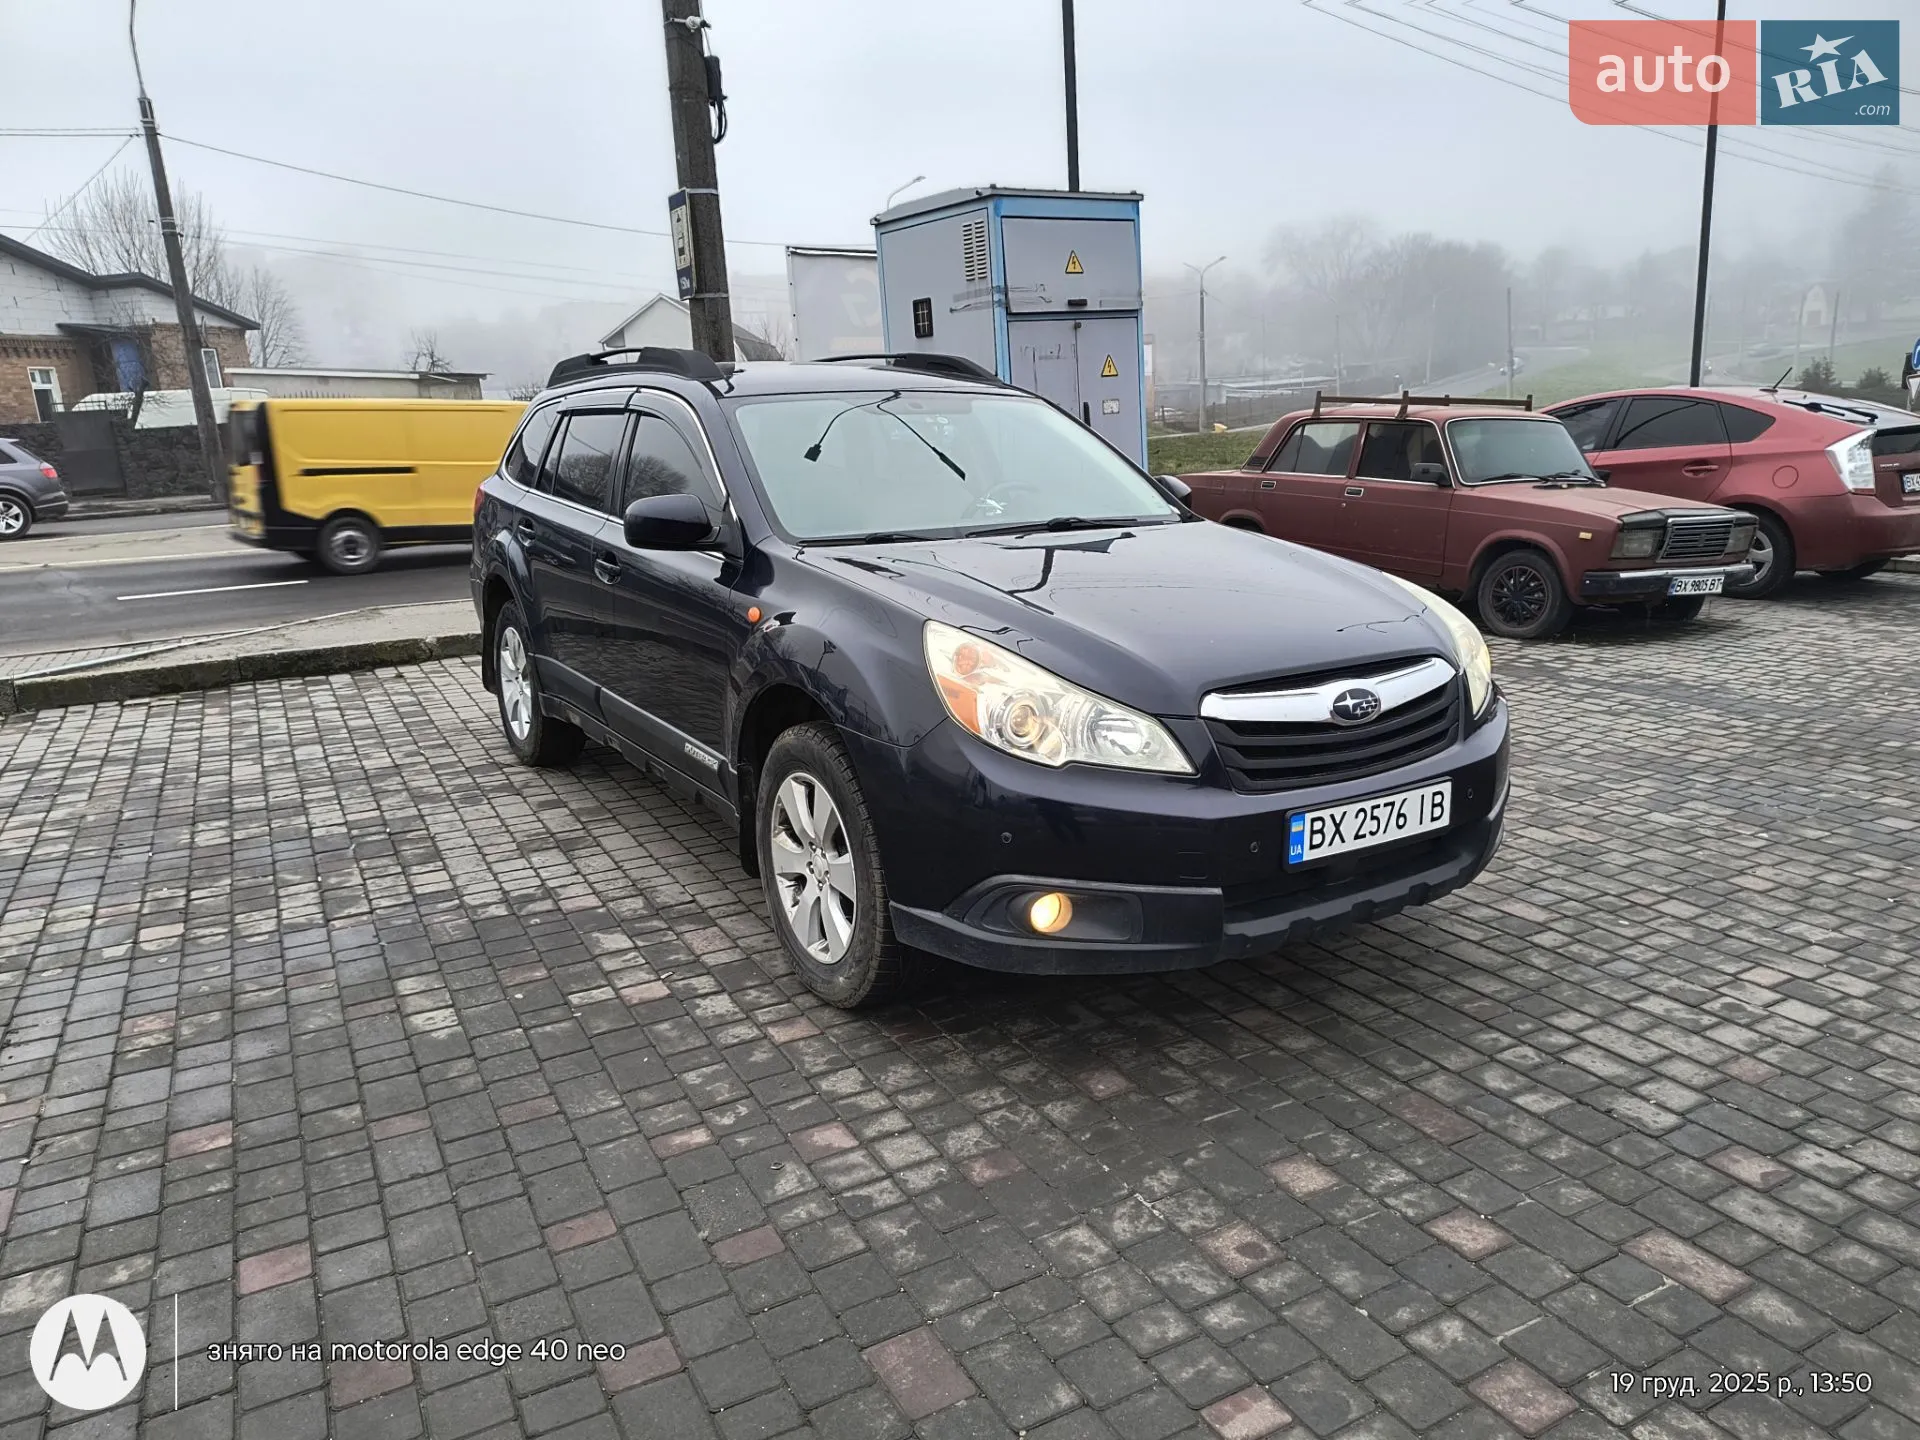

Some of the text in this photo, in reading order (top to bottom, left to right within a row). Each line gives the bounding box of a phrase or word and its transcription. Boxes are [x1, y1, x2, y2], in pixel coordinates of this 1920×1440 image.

[1309, 790, 1445, 850] BX 2576 IB
[1290, 844, 1303, 856] UA
